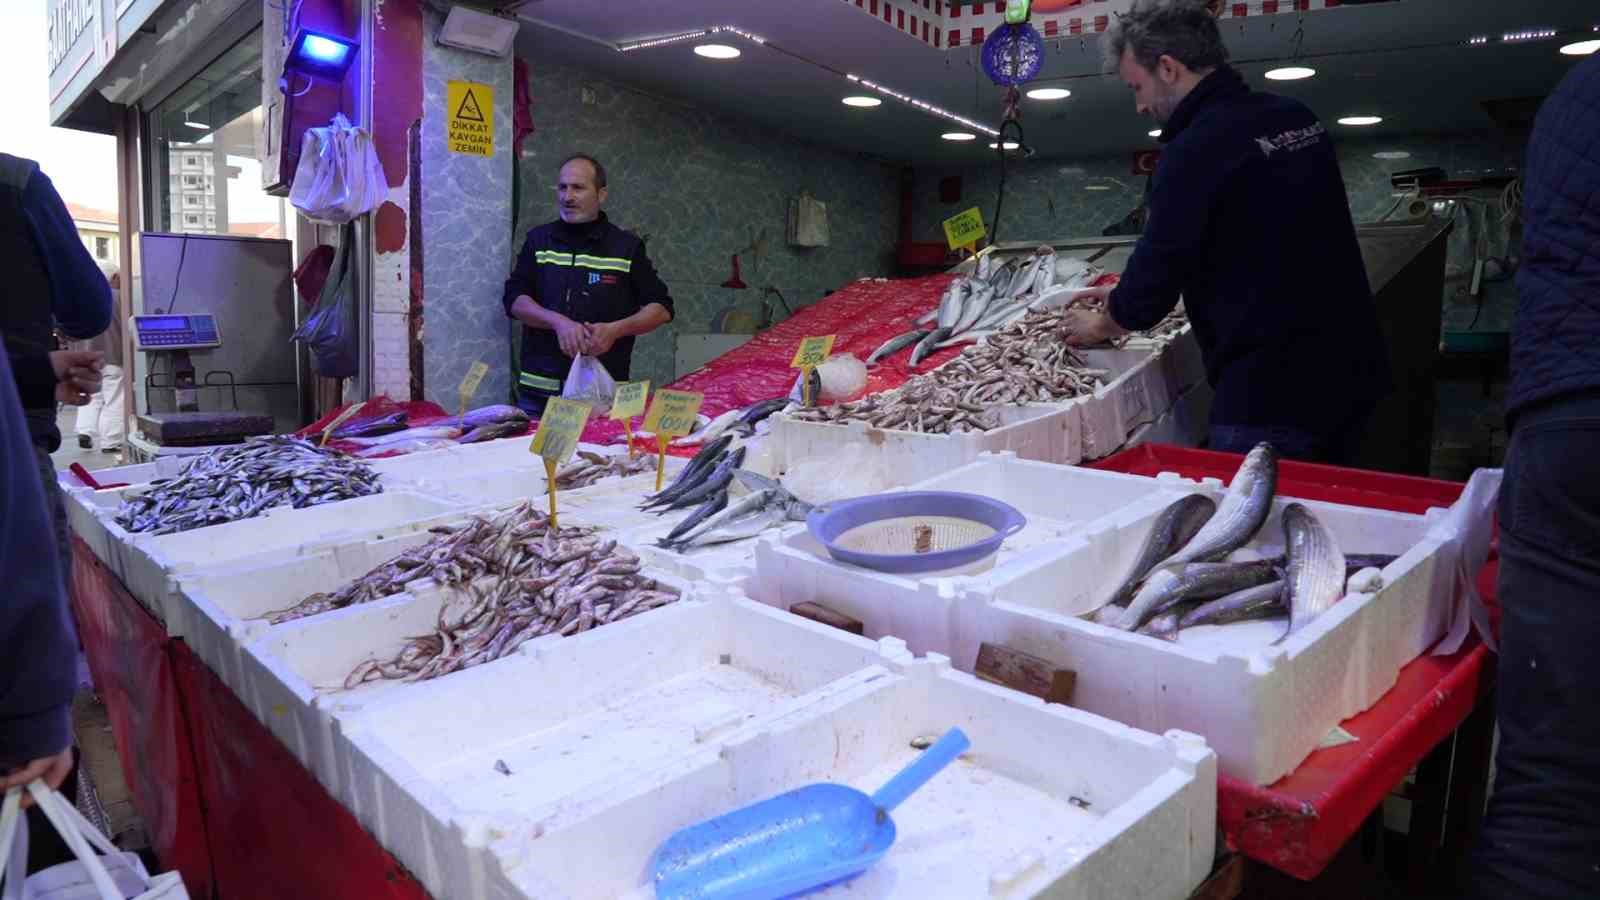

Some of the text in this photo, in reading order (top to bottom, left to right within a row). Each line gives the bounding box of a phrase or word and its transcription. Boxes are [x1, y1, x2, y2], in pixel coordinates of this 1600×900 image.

[452, 120, 488, 132] DİKKAT
[449, 131, 491, 144] KAYGAN
[455, 143, 487, 155] ZEMİN
